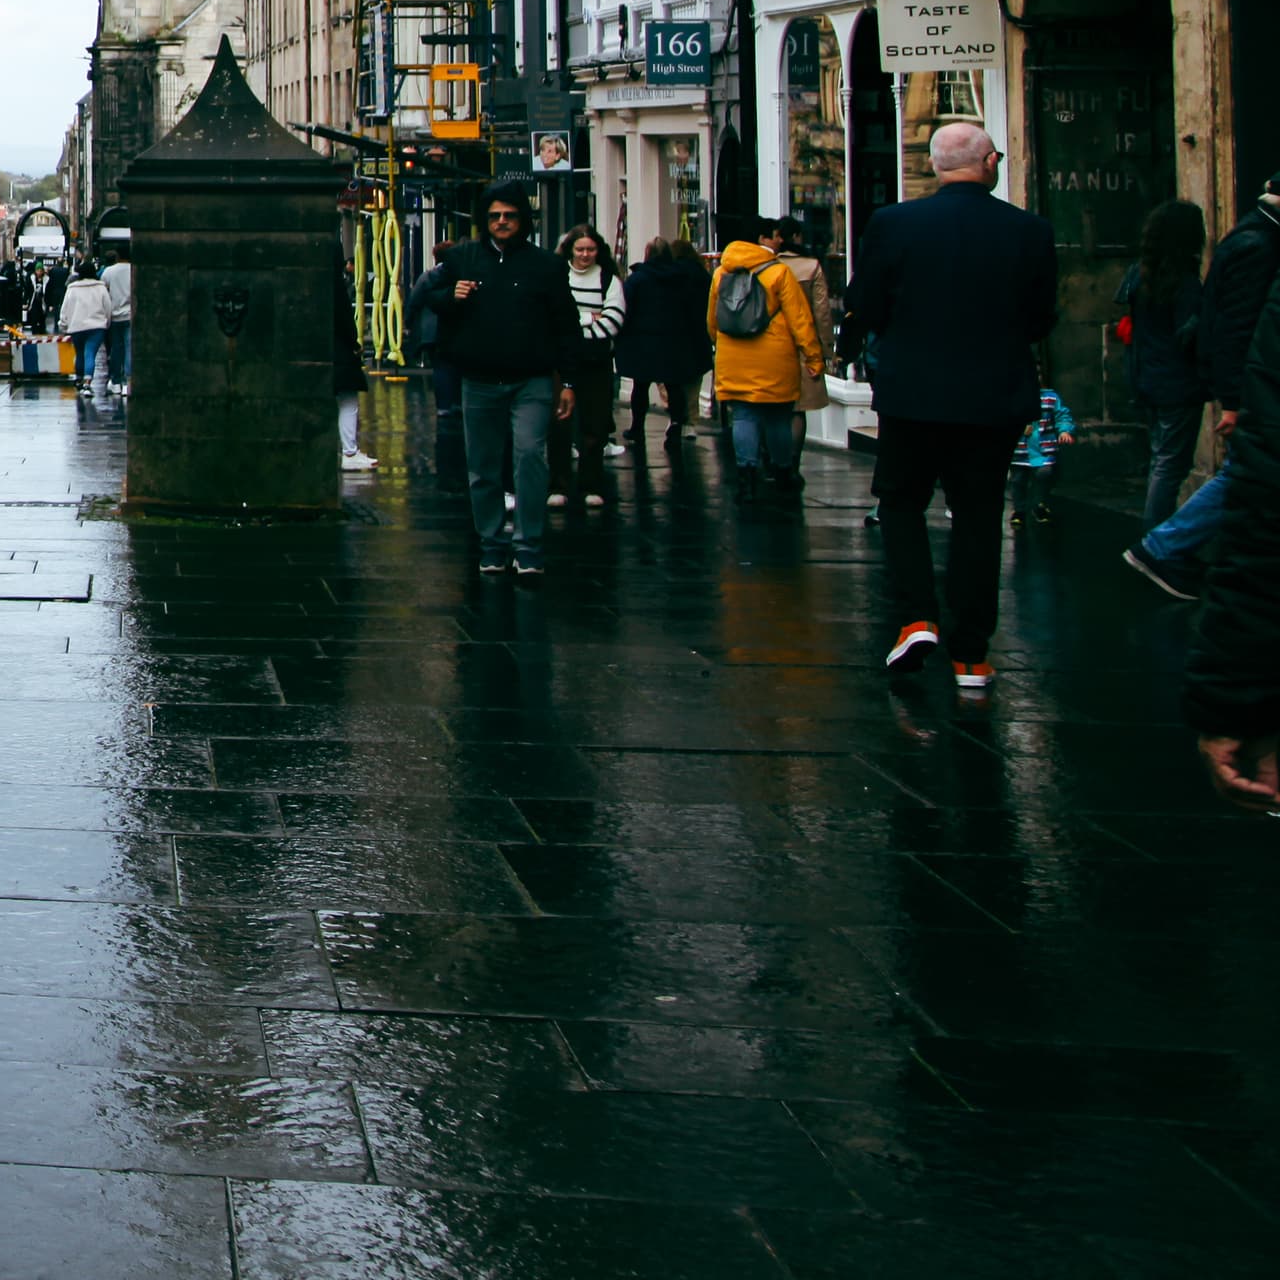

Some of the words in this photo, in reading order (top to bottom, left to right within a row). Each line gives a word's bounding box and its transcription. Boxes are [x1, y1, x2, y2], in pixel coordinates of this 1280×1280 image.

[904, 5, 970, 17] TASTE
[926, 25, 952, 36] OF
[654, 31, 702, 57] 166
[886, 44, 996, 57] SCOTLAND
[652, 64, 675, 74] High
[677, 63, 704, 73] Street
